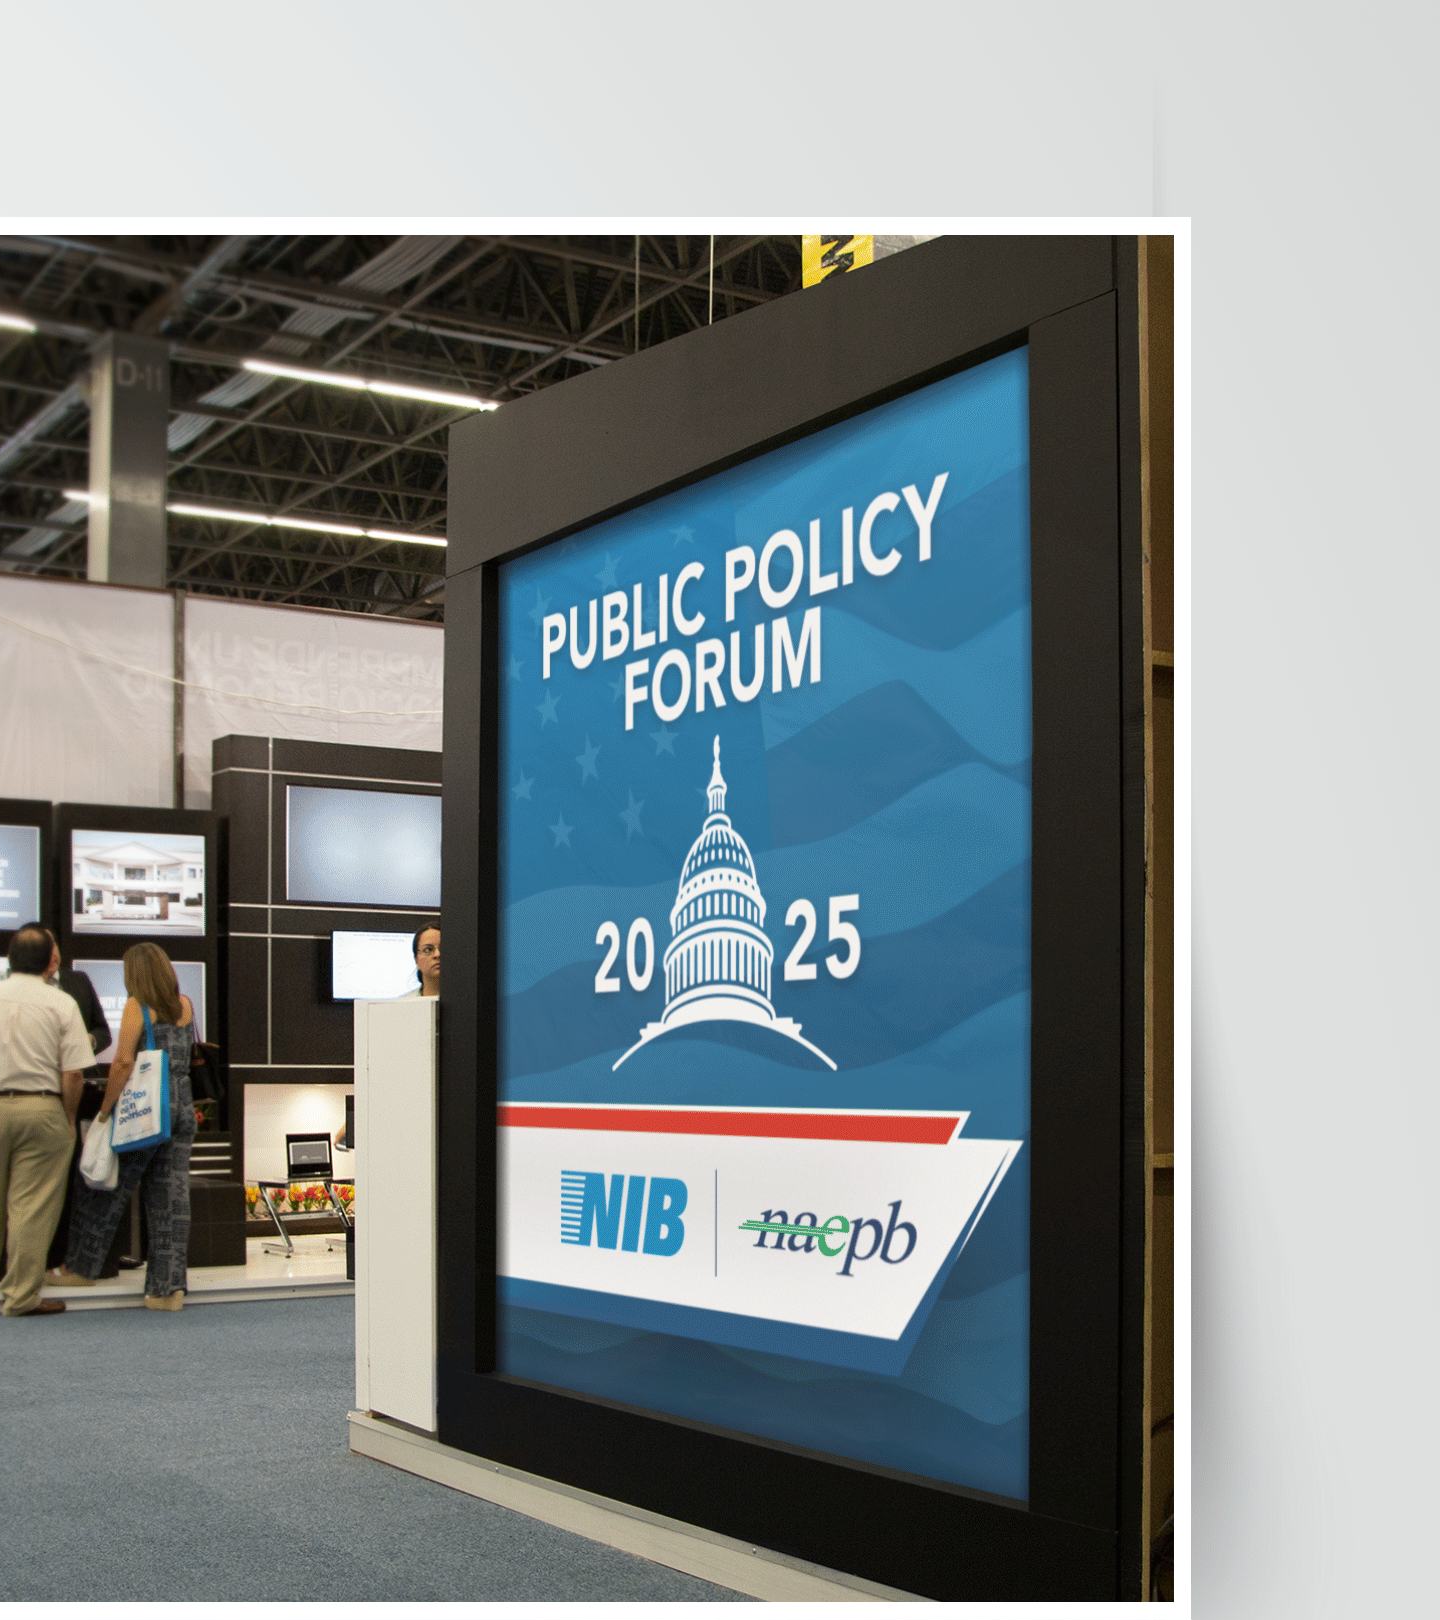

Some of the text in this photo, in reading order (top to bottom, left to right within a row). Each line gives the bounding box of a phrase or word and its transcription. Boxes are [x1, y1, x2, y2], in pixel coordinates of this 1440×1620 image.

[542, 472, 949, 679] PUBLIC POLICY
[625, 606, 822, 731] FORUM
[594, 894, 861, 993] 20 25
[560, 1169, 918, 1277] NIB naepb
